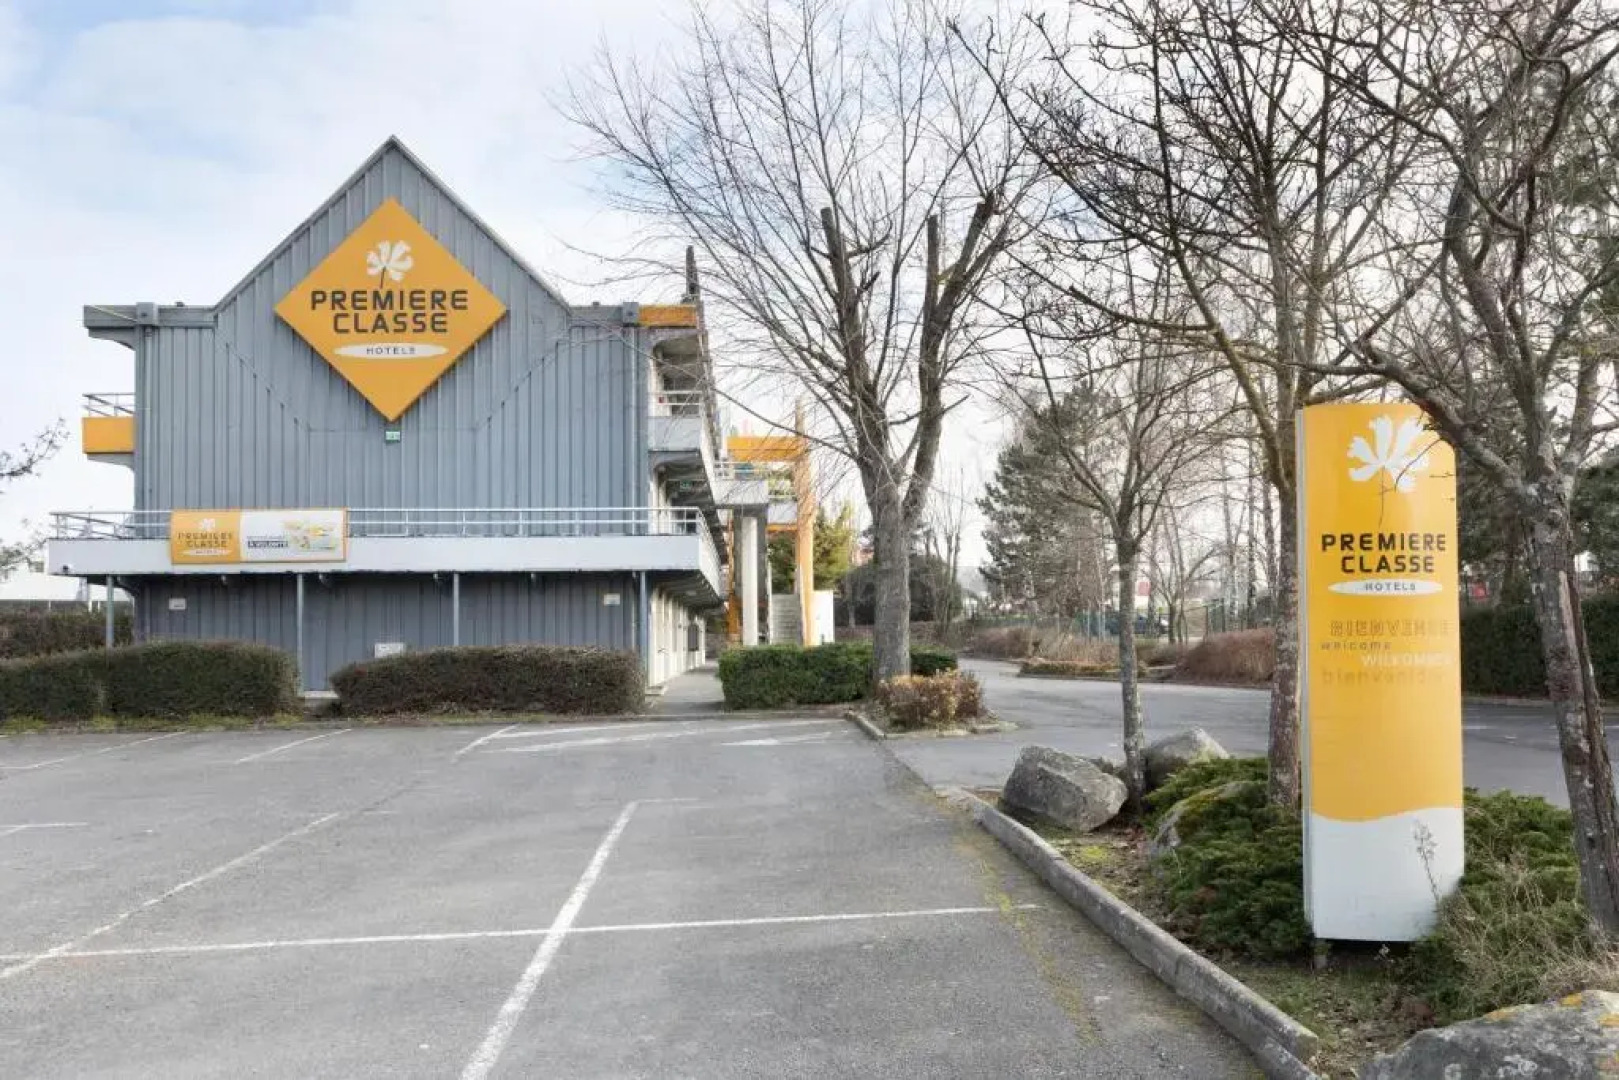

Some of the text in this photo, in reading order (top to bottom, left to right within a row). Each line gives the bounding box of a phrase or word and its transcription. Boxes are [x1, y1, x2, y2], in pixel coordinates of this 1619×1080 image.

[310, 289, 469, 311] PREMIERE
[333, 312, 448, 334] CLASSE
[366, 347, 416, 355] HOTELS
[1321, 533, 1446, 552] PREMIERE
[1341, 555, 1435, 573] CLASSE
[1365, 582, 1416, 591] HOTELS
[1330, 620, 1453, 636] BIENVENE
